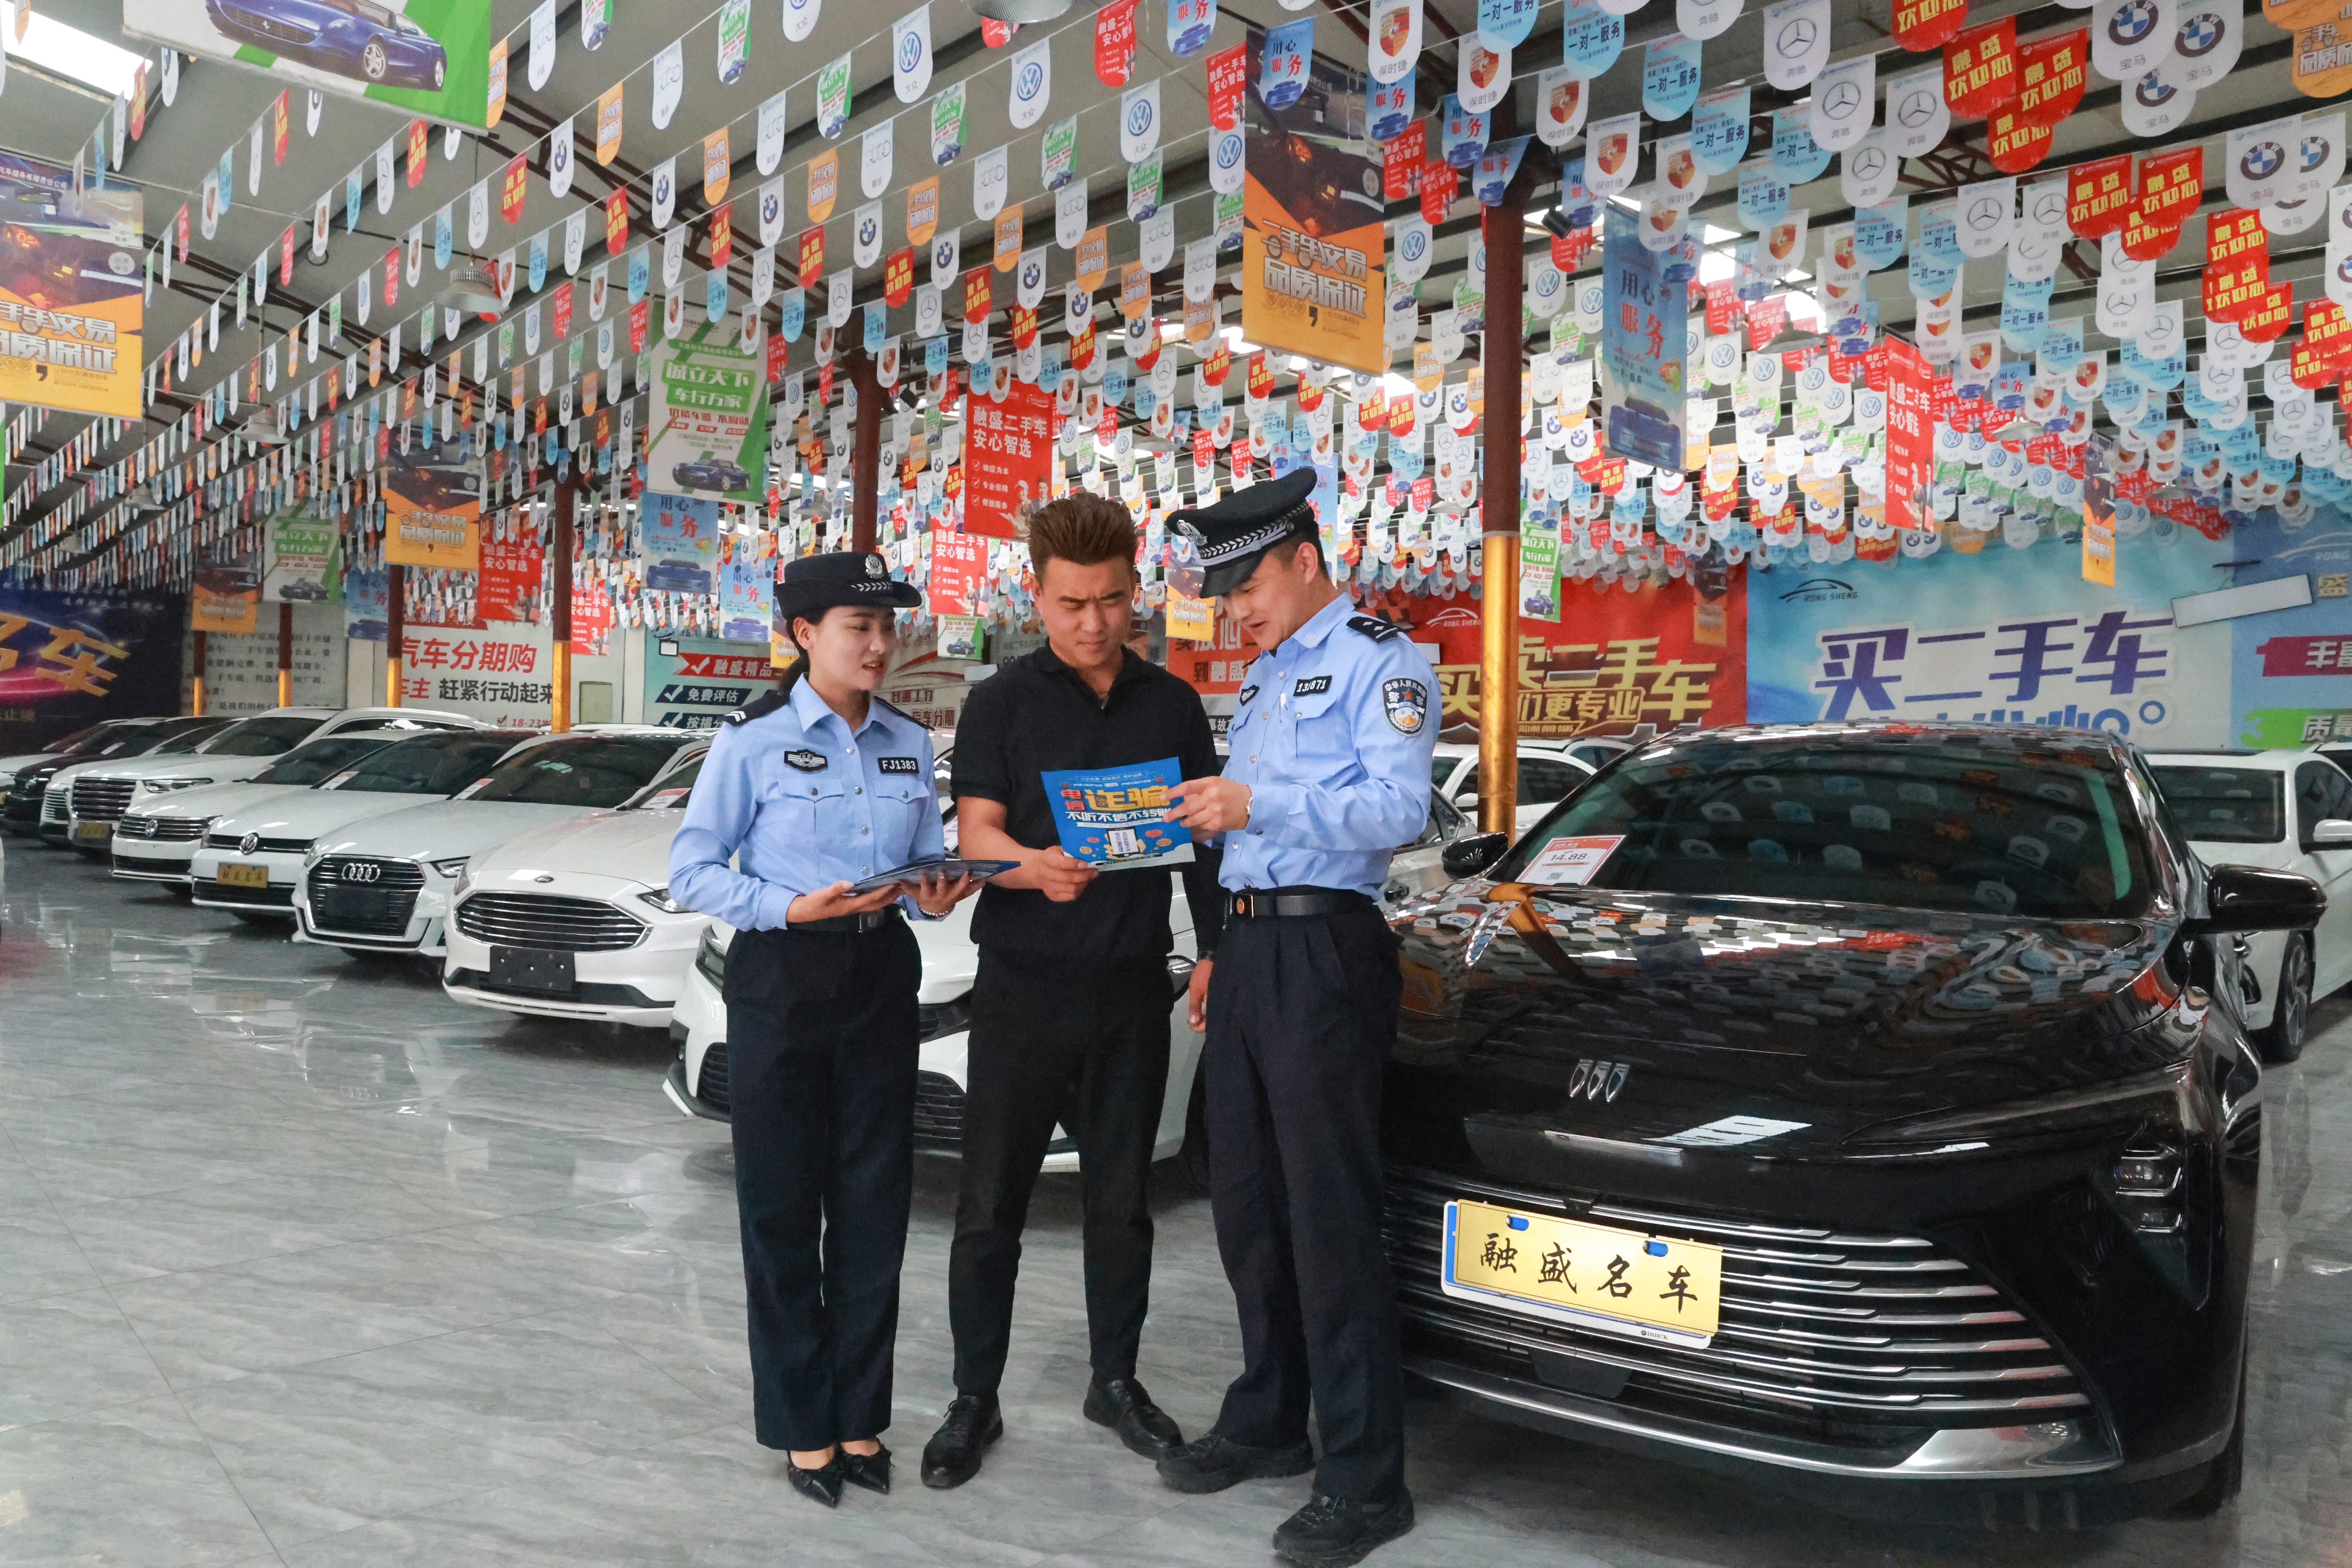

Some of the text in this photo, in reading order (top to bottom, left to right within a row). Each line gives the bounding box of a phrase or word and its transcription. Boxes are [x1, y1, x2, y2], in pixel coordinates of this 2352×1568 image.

[1178, 0, 1209, 22] 服务
[1482, 0, 1534, 21] 一对一服务
[1699, 11, 1719, 26] 奔驰
[1568, 21, 1620, 51] 一对一服务
[1272, 40, 1296, 55] 用心
[1952, 34, 2001, 76] 融盛
[1271, 54, 1303, 77] 服务
[1379, 60, 1408, 77] 保时捷
[2025, 47, 2072, 86] 融盛
[2120, 54, 2146, 71] 宝马
[1648, 67, 1697, 93] 一对一服务
[1948, 54, 2013, 101] 欢迎您
[2187, 65, 2212, 82] 宝马
[906, 81, 918, 94] 大众
[2021, 66, 2082, 111] 欢迎您
[1375, 87, 1406, 110] 服务
[1469, 91, 1498, 107] 保时捷
[1022, 109, 1036, 119] 大众
[2146, 115, 2169, 129] 宝马
[1452, 118, 1483, 138] 服务
[1548, 125, 1575, 141] 保时捷
[1696, 125, 1745, 148] 一对一服务
[1134, 143, 1147, 154] 大众
[1777, 138, 1824, 157] 一对一服
[1223, 176, 1236, 186] 大众
[1595, 178, 1625, 191] 保时捷
[2076, 171, 2120, 202] 融盛
[2147, 163, 2190, 194] 融盛
[1742, 187, 1786, 207] 一对一服务
[2071, 188, 2128, 223] 欢迎您
[2143, 179, 2199, 214] 欢迎您
[1857, 229, 1903, 247] 一对一服务
[2125, 225, 2177, 247] 欢迎
[2215, 215, 2256, 242] 融盛
[2211, 230, 2265, 261] 欢迎您
[1263, 256, 1367, 318] 品质保证
[2219, 267, 2258, 291] 融盛
[2215, 281, 2265, 309] 欢迎您
[2004, 312, 2044, 325] 一对一服务
[2243, 307, 2288, 331] 欢迎您
[666, 361, 749, 387] 诚立天下
[675, 388, 743, 408] 车行万家
[973, 406, 1047, 438] 融盛二手车
[973, 429, 1032, 458] 安心智选
[983, 464, 1009, 475] 诚信为本
[983, 481, 1009, 493] 专业保障
[661, 496, 689, 512] 用心
[660, 512, 699, 538] 服务
[936, 529, 985, 548] 融盛二手车
[935, 544, 975, 561] 安心智选
[1830, 592, 1858, 601] SHENG
[1194, 660, 1251, 683] 到融盛
[1815, 611, 2174, 720] 买二手车
[439, 678, 553, 704] 赶紧行动起来
[687, 688, 739, 703] 免费评估
[1385, 679, 1426, 698] 中华人民共和国
[882, 760, 916, 770] FJ1383
[1479, 1232, 1699, 1314] 融盛名车
